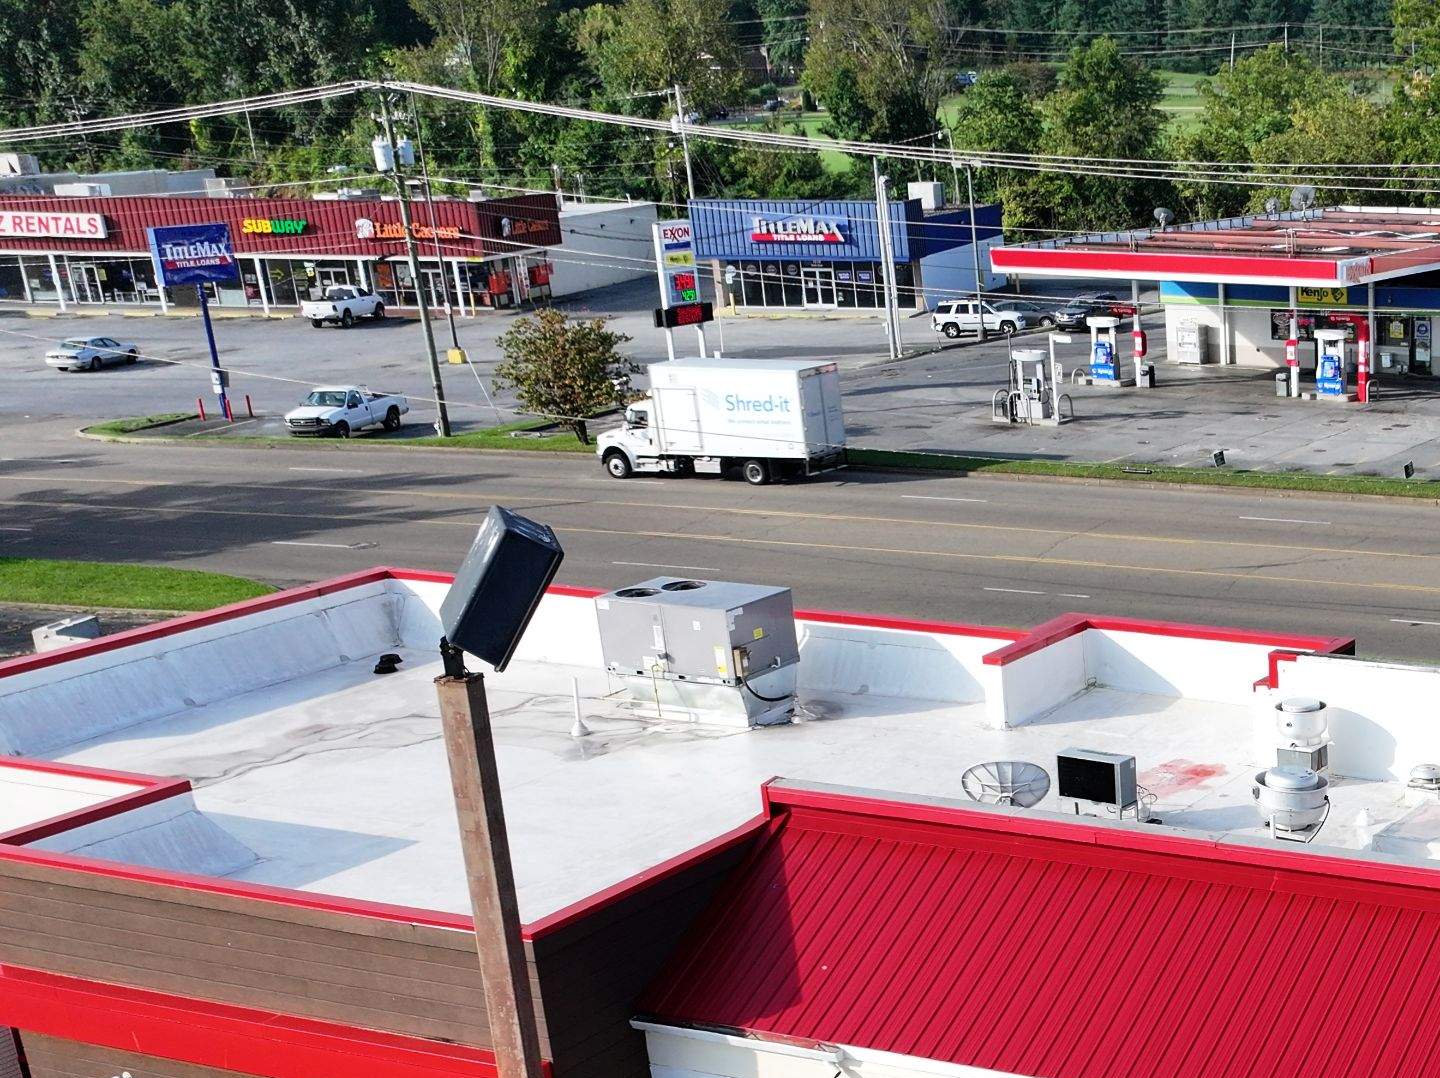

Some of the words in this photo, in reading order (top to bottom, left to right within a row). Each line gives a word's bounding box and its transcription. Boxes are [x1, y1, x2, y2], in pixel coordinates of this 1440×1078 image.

[12, 215, 99, 235] RENTALS
[242, 219, 306, 234] SUBWAY
[663, 226, 691, 243] EXXON
[175, 259, 196, 269] TITLE
[196, 257, 221, 267] LOANS
[724, 394, 791, 412] Shred-it
